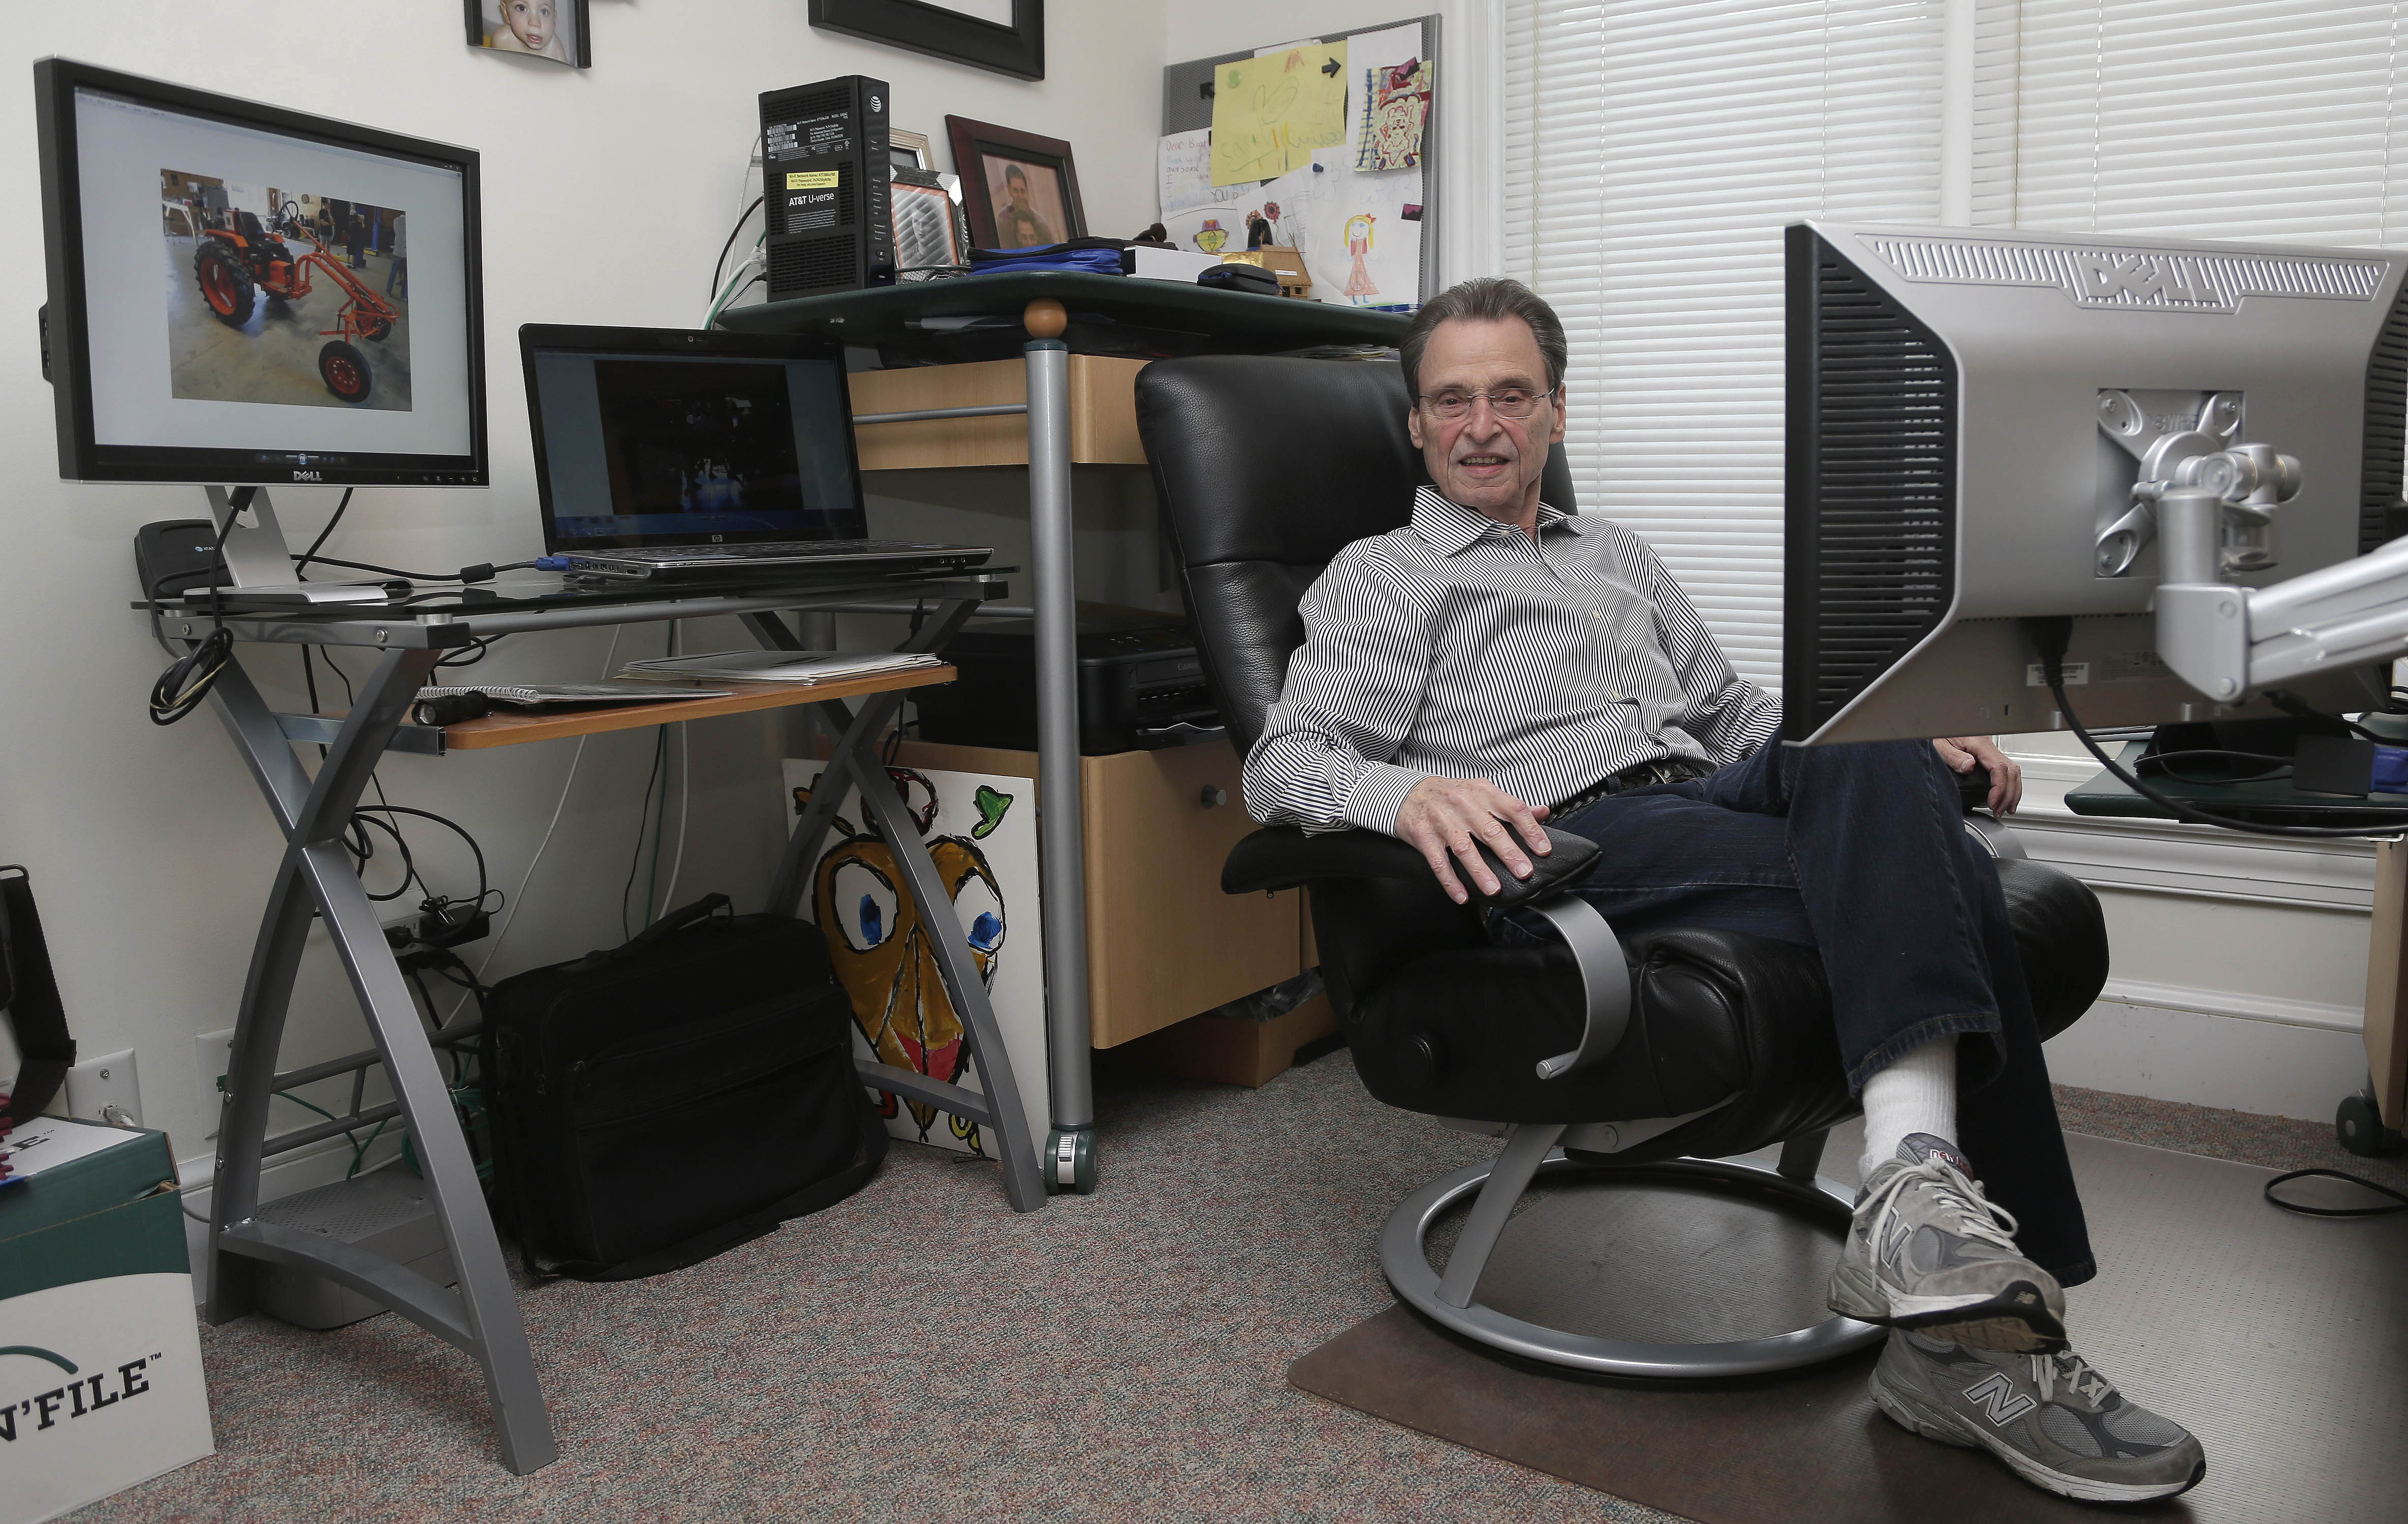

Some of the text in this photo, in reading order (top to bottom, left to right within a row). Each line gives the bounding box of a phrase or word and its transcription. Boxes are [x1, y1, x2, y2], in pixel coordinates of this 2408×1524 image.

[789, 193, 834, 206] AT&T U-verse
[2075, 255, 2221, 303] DELL
[293, 471, 323, 481] DELL
[1962, 1371, 2038, 1427] N
